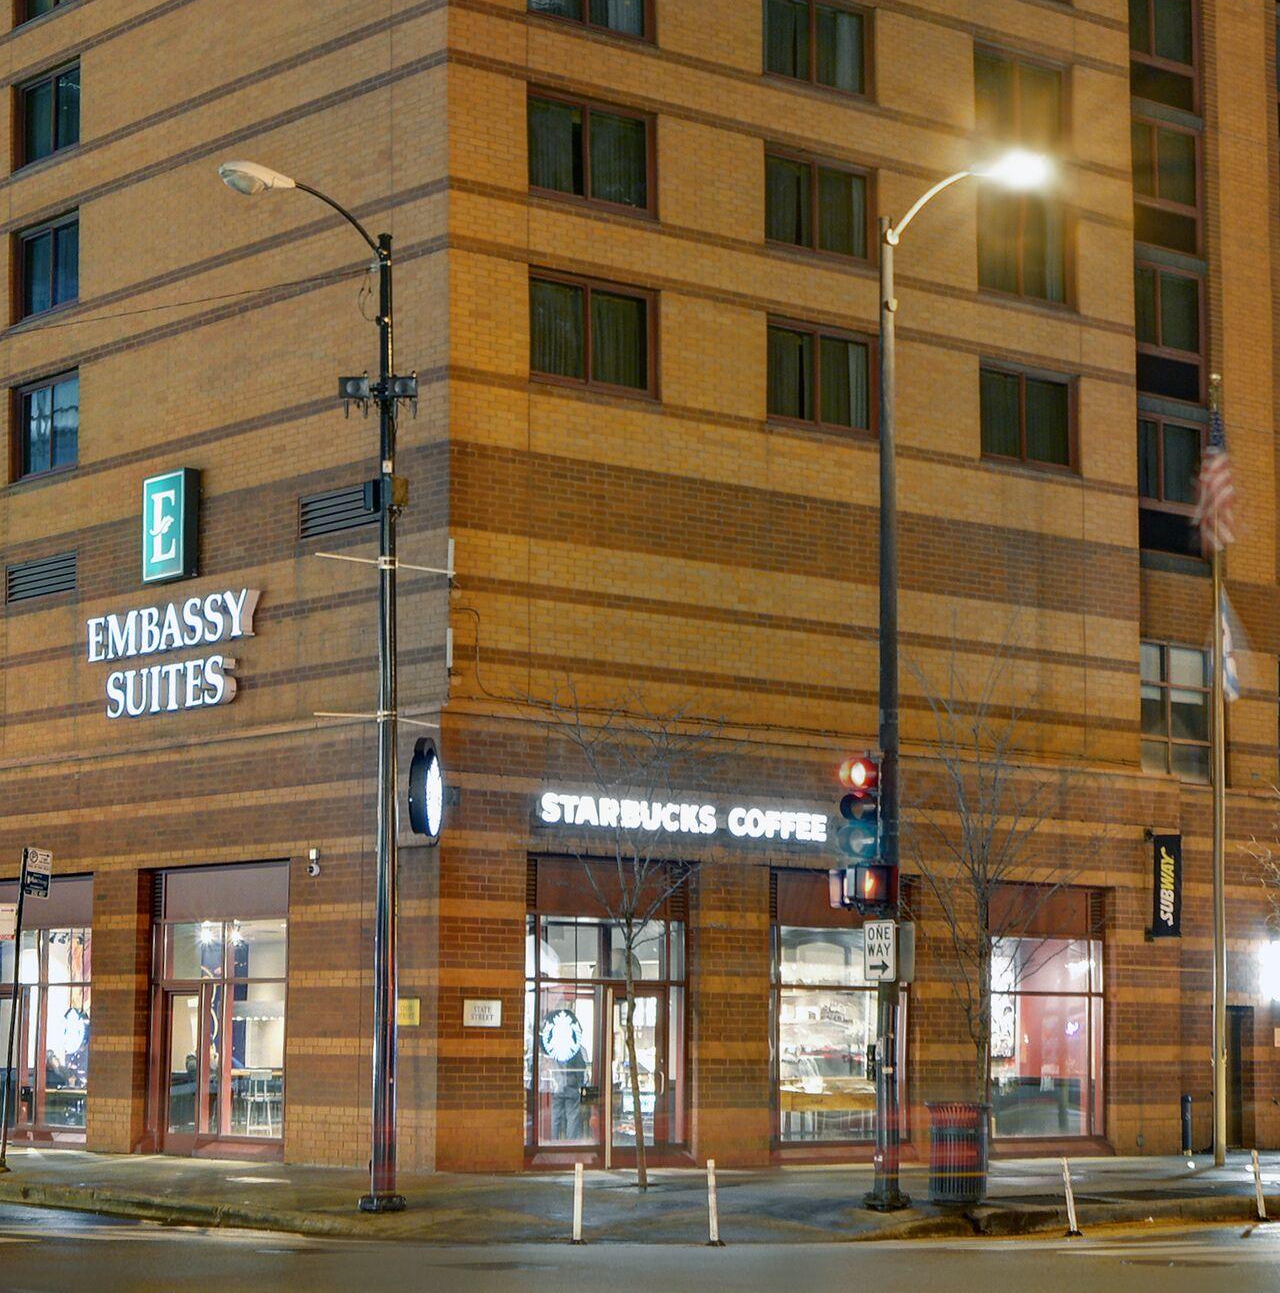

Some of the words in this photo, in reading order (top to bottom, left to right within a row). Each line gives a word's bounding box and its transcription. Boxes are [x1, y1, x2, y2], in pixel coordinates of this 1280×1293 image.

[87, 588, 252, 663] EMBASSY
[106, 655, 228, 719] SUITES
[541, 792, 717, 835] STARBUCKS
[728, 807, 827, 842] COFFEE
[1160, 846, 1175, 927] SUBWAY
[867, 942, 891, 957] WAY
[868, 926, 891, 941] ONE
[471, 1013, 494, 1021] STREET
[473, 1005, 492, 1013] STATE
